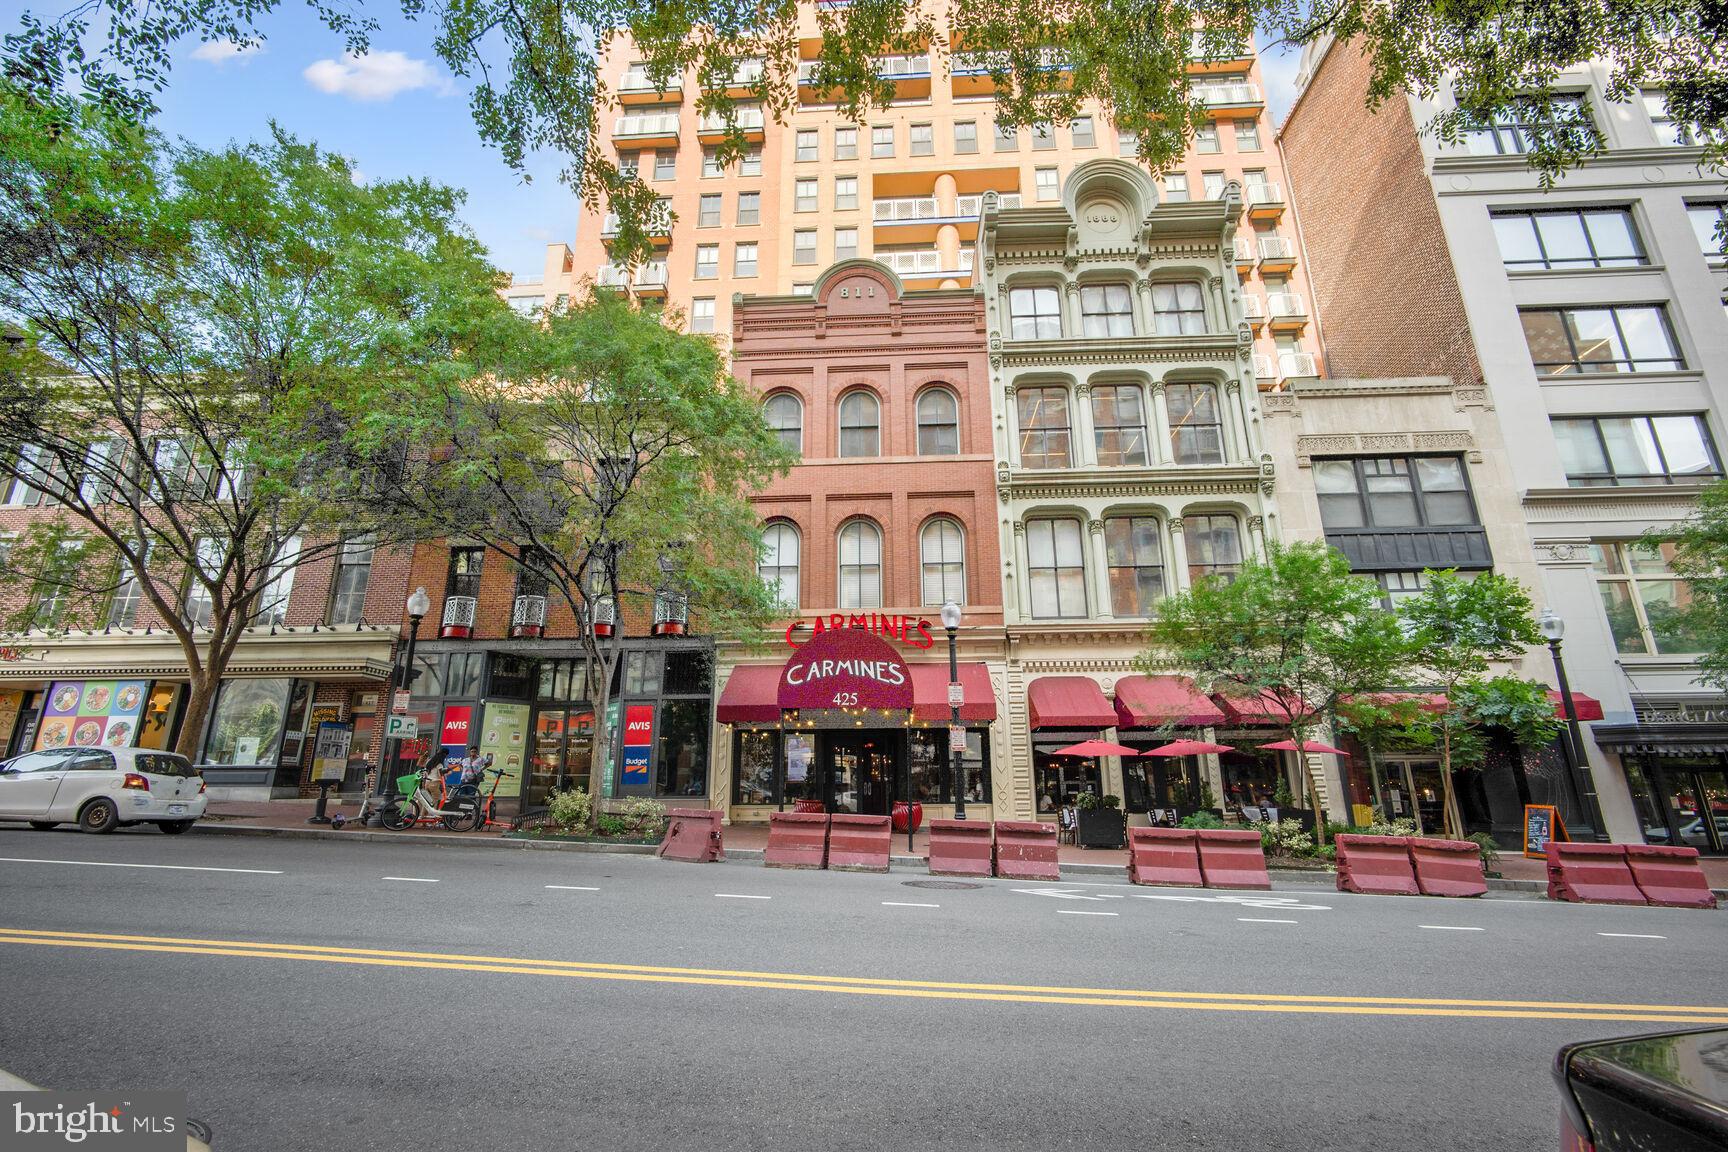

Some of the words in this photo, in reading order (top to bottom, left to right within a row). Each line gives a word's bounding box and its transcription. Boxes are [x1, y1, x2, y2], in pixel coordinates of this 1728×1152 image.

[786, 659, 905, 685] CARMINE'S
[832, 692, 858, 706] 425
[446, 721, 468, 730] AVIS
[628, 721, 651, 730] AVIS
[625, 758, 648, 766] Budget
